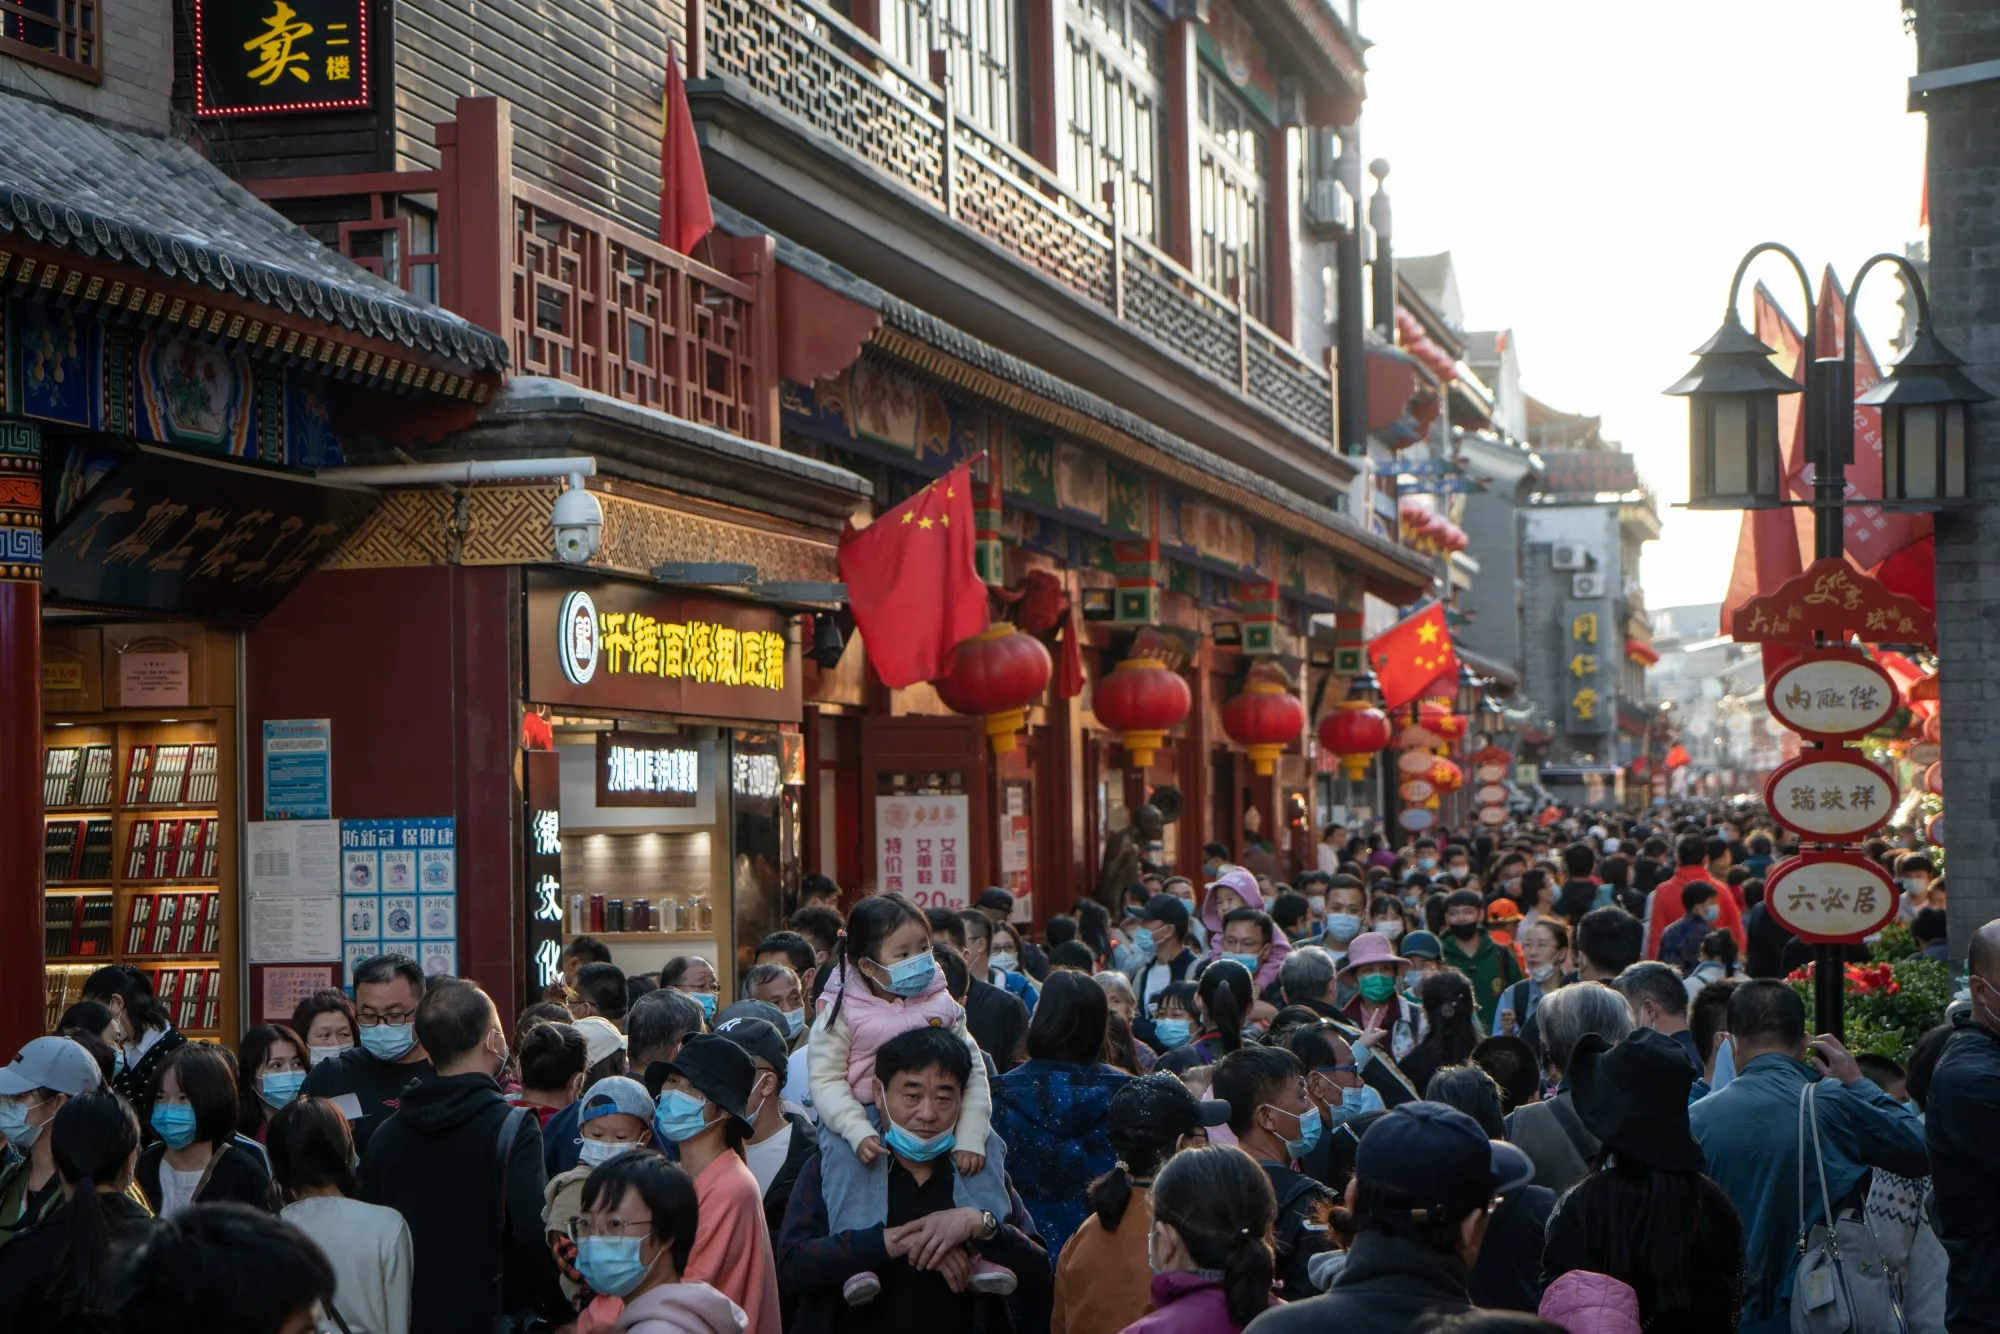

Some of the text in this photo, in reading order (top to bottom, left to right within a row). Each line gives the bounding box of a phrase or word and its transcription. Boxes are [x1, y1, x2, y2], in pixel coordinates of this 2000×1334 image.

[243, 0, 314, 86] 卖
[325, 23, 351, 81] 二楼
[1568, 612, 1598, 721] 同仁堂
[1790, 784, 1877, 813] 瑞蚨祥
[342, 827, 454, 847] 防新冠 保健康
[347, 853, 375, 863] 戴口罩
[384, 852, 412, 862] 勤洗手
[423, 852, 451, 862] 通新风
[915, 838, 934, 885] 女单鞋
[352, 899, 376, 909] 一米线
[386, 899, 413, 909] 不聚集
[424, 898, 451, 909] 分开吃
[532, 809, 563, 989] 银文化
[1787, 884, 1878, 916] 六必居
[386, 945, 413, 955] 巧安排
[424, 944, 451, 955] 零报告
[717, 1017, 742, 1032] NY
